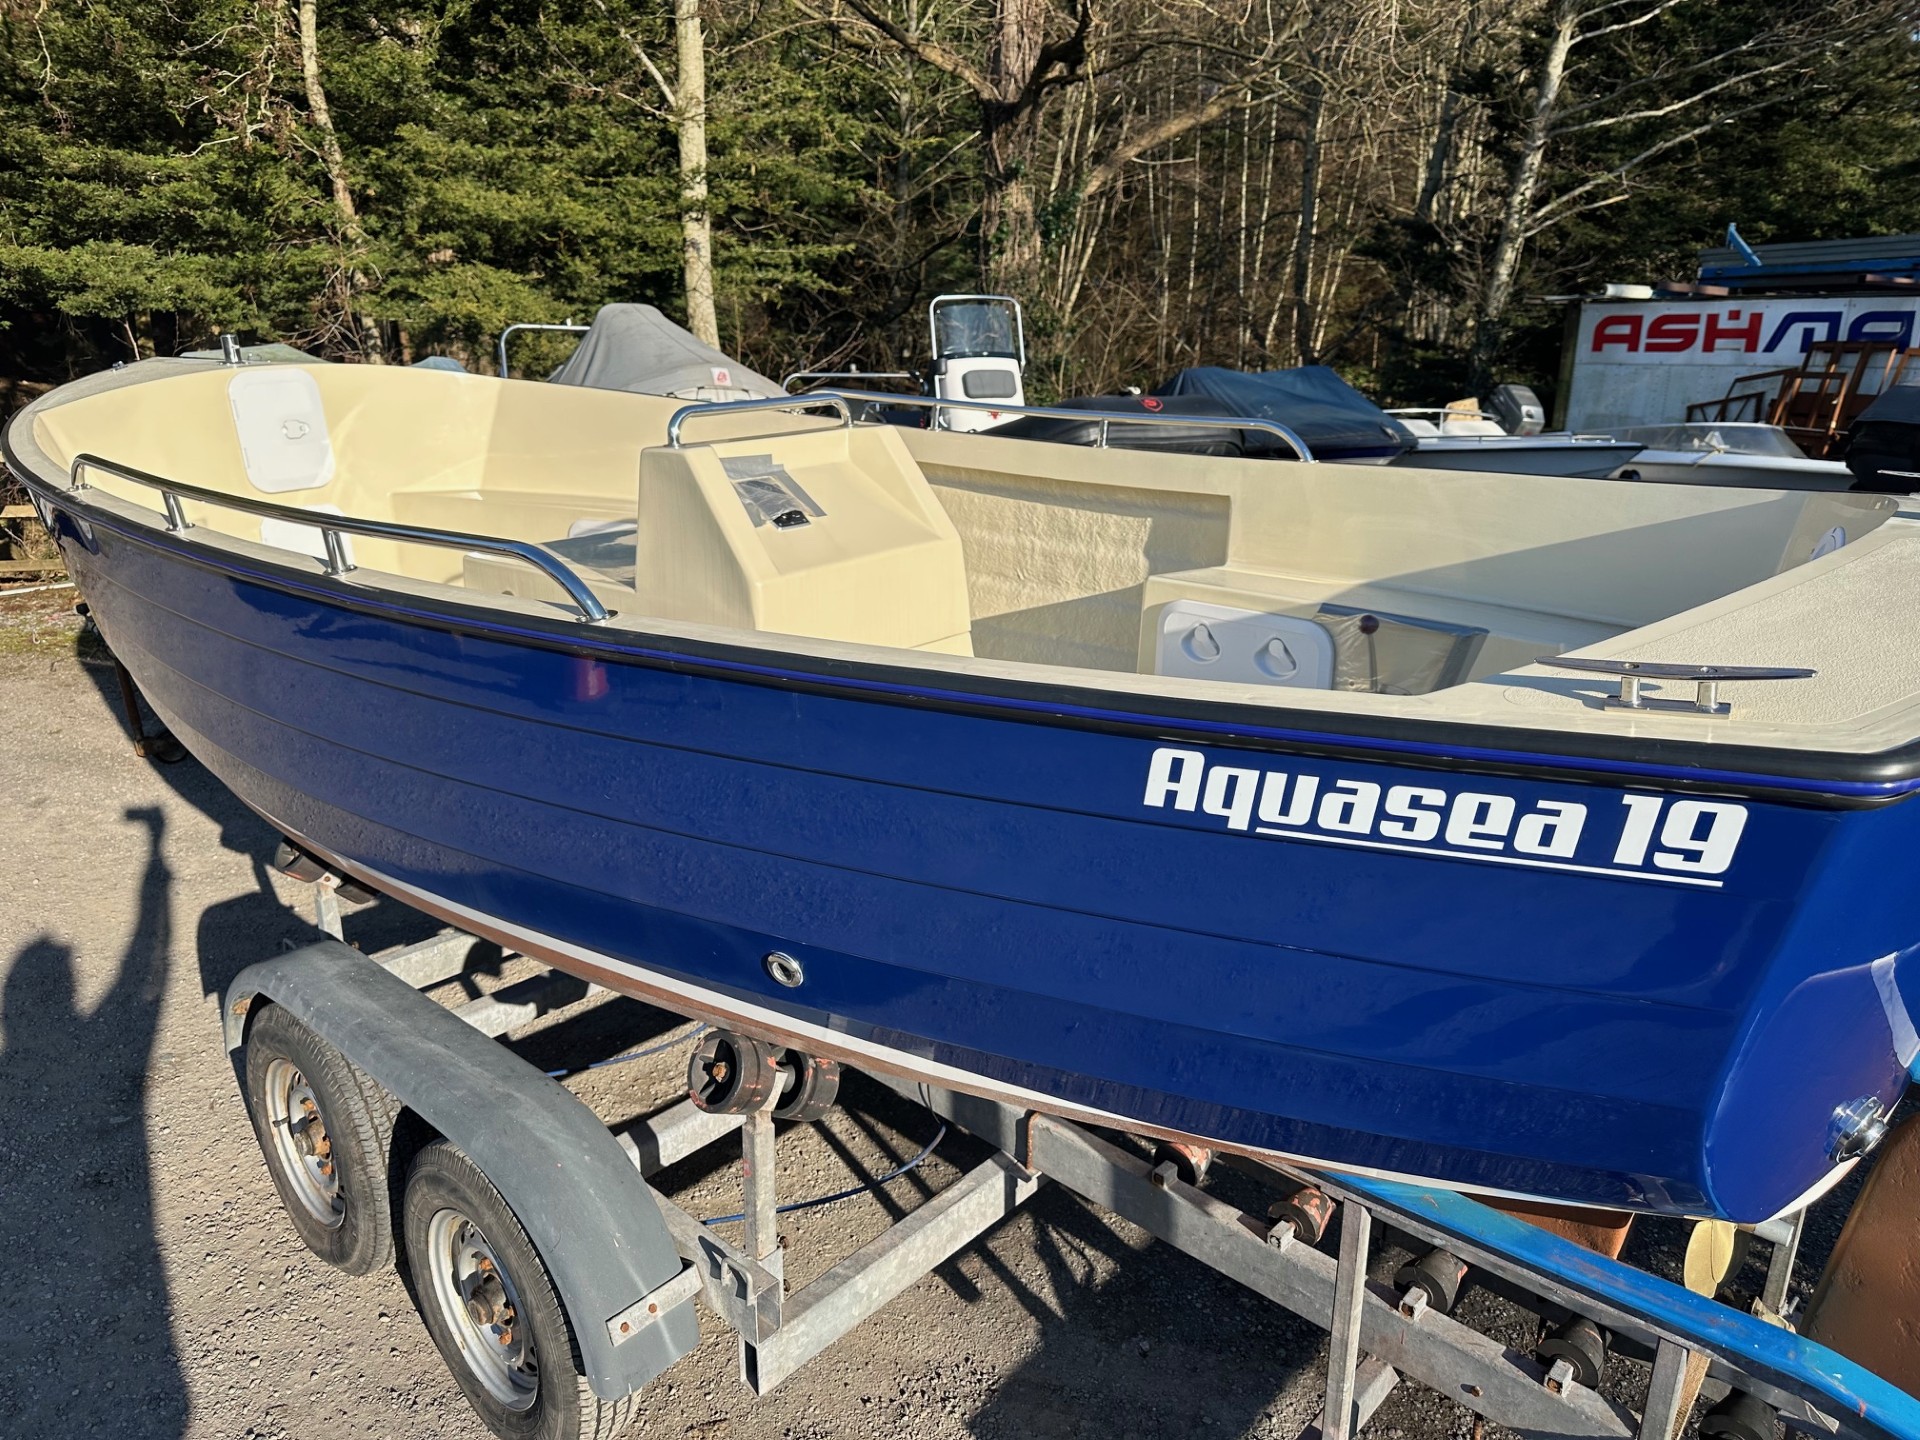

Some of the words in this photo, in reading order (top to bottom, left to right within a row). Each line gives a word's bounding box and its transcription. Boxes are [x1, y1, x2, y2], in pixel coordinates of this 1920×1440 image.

[1592, 310, 1920, 354] ASHMA
[1143, 747, 1587, 859] Aquasea
[1613, 794, 1748, 874] 19
